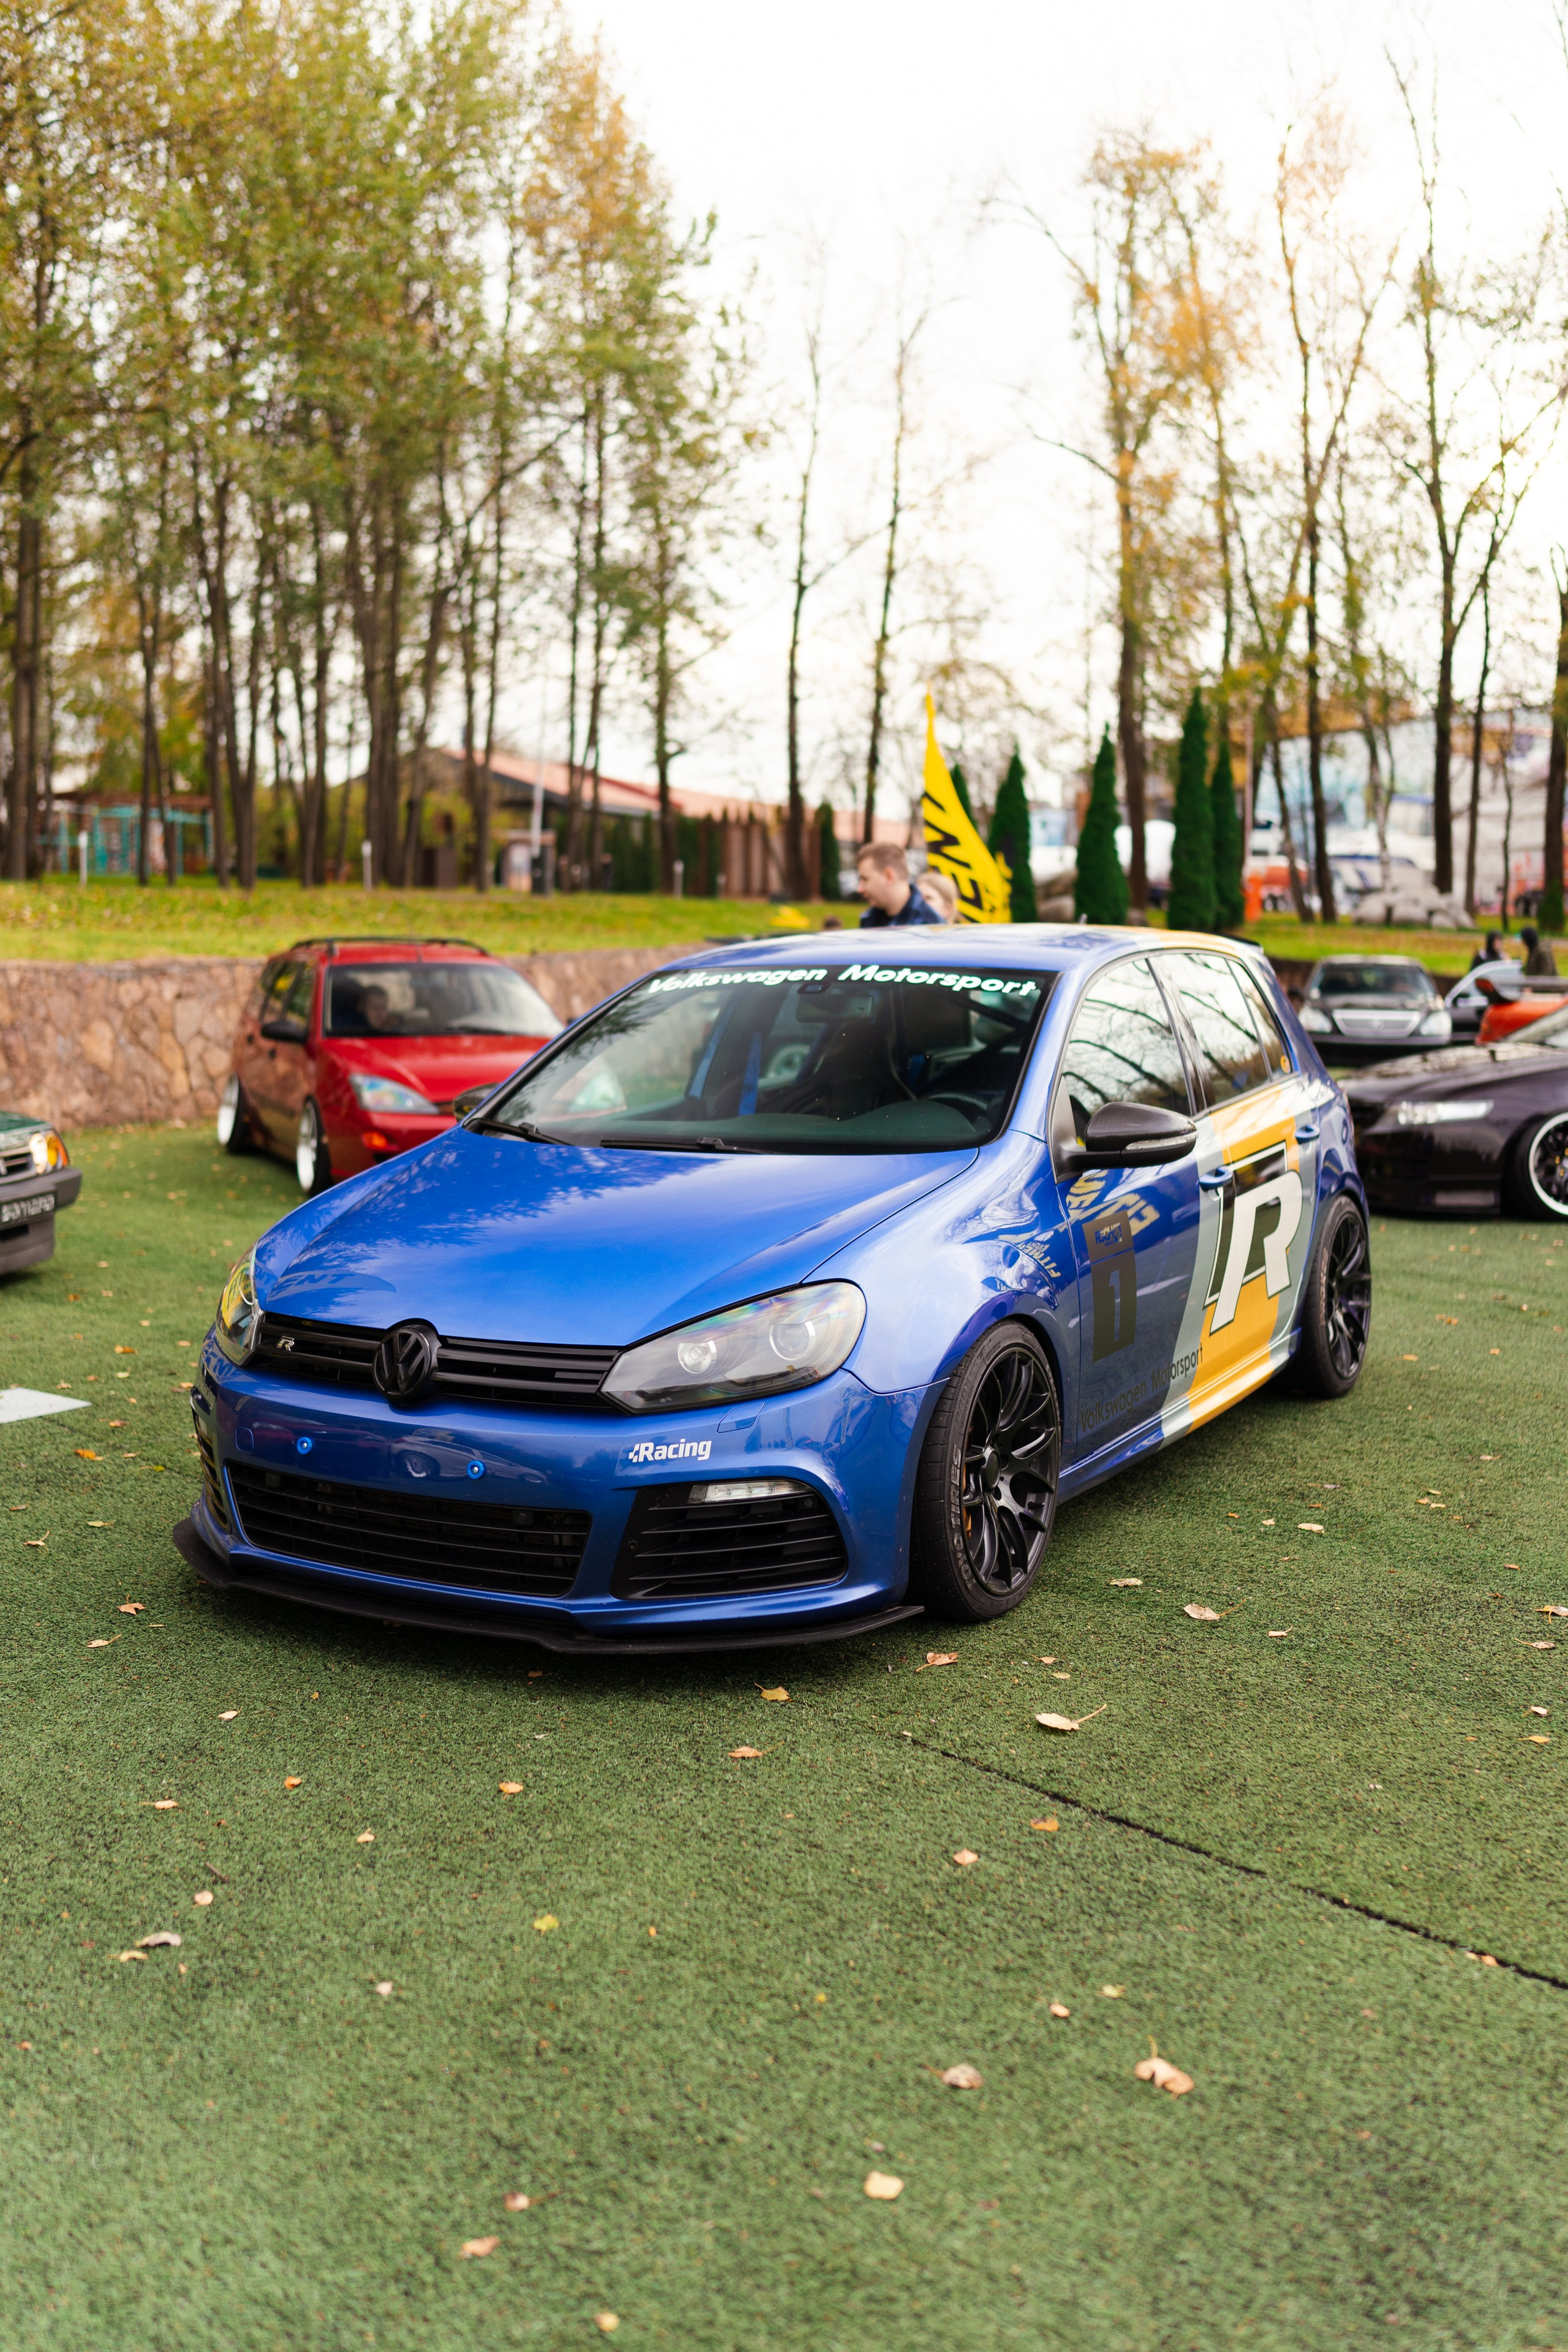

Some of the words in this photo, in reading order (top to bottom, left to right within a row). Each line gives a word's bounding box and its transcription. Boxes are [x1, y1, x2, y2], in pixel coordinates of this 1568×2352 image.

[649, 969, 828, 993] Volkswagen
[838, 965, 1037, 996] Motorsport
[1209, 1169, 1303, 1334] R
[277, 1335, 295, 1352] R
[1080, 1380, 1147, 1433] Volkswagen
[1151, 1342, 1203, 1393] Motorsport
[637, 1439, 712, 1463] Racing
[951, 1443, 961, 1529] TIRES
